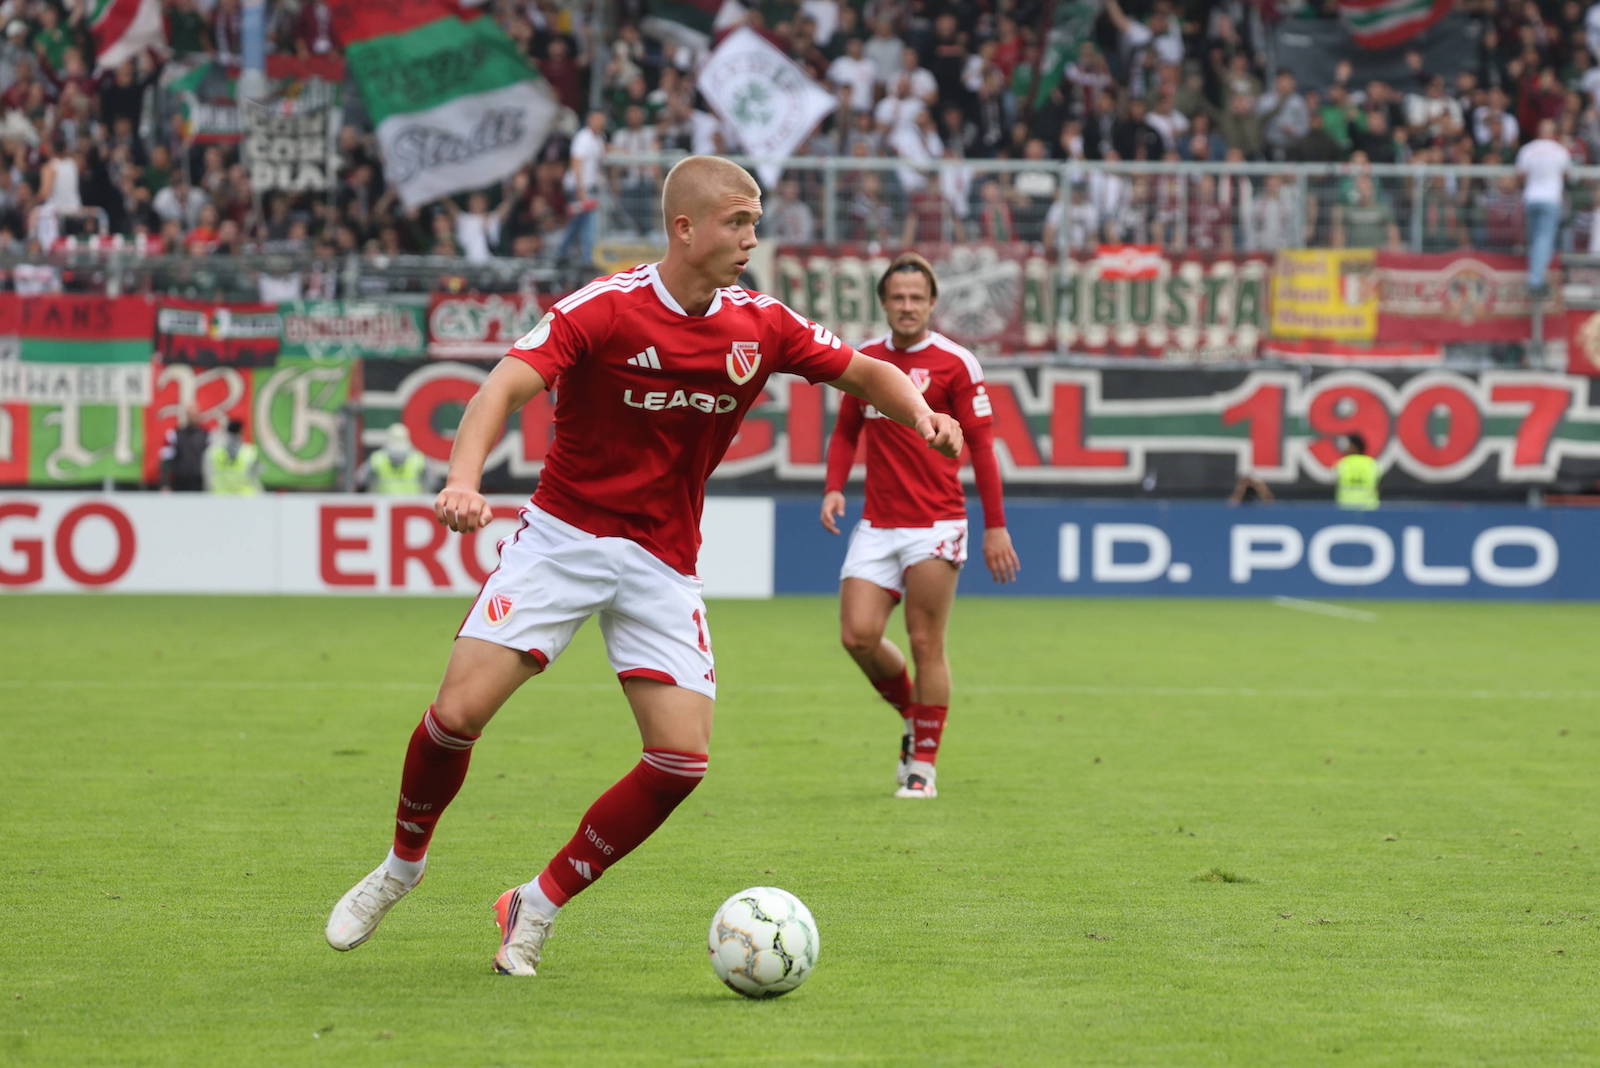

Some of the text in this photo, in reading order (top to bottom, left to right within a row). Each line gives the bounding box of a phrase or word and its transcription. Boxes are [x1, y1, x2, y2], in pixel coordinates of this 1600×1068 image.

[22, 301, 113, 331] FANS
[623, 389, 738, 414] LEAGO
[1216, 378, 1575, 474] 1907
[1058, 522, 1560, 587] ID. POLO
[584, 823, 615, 856] 1966
